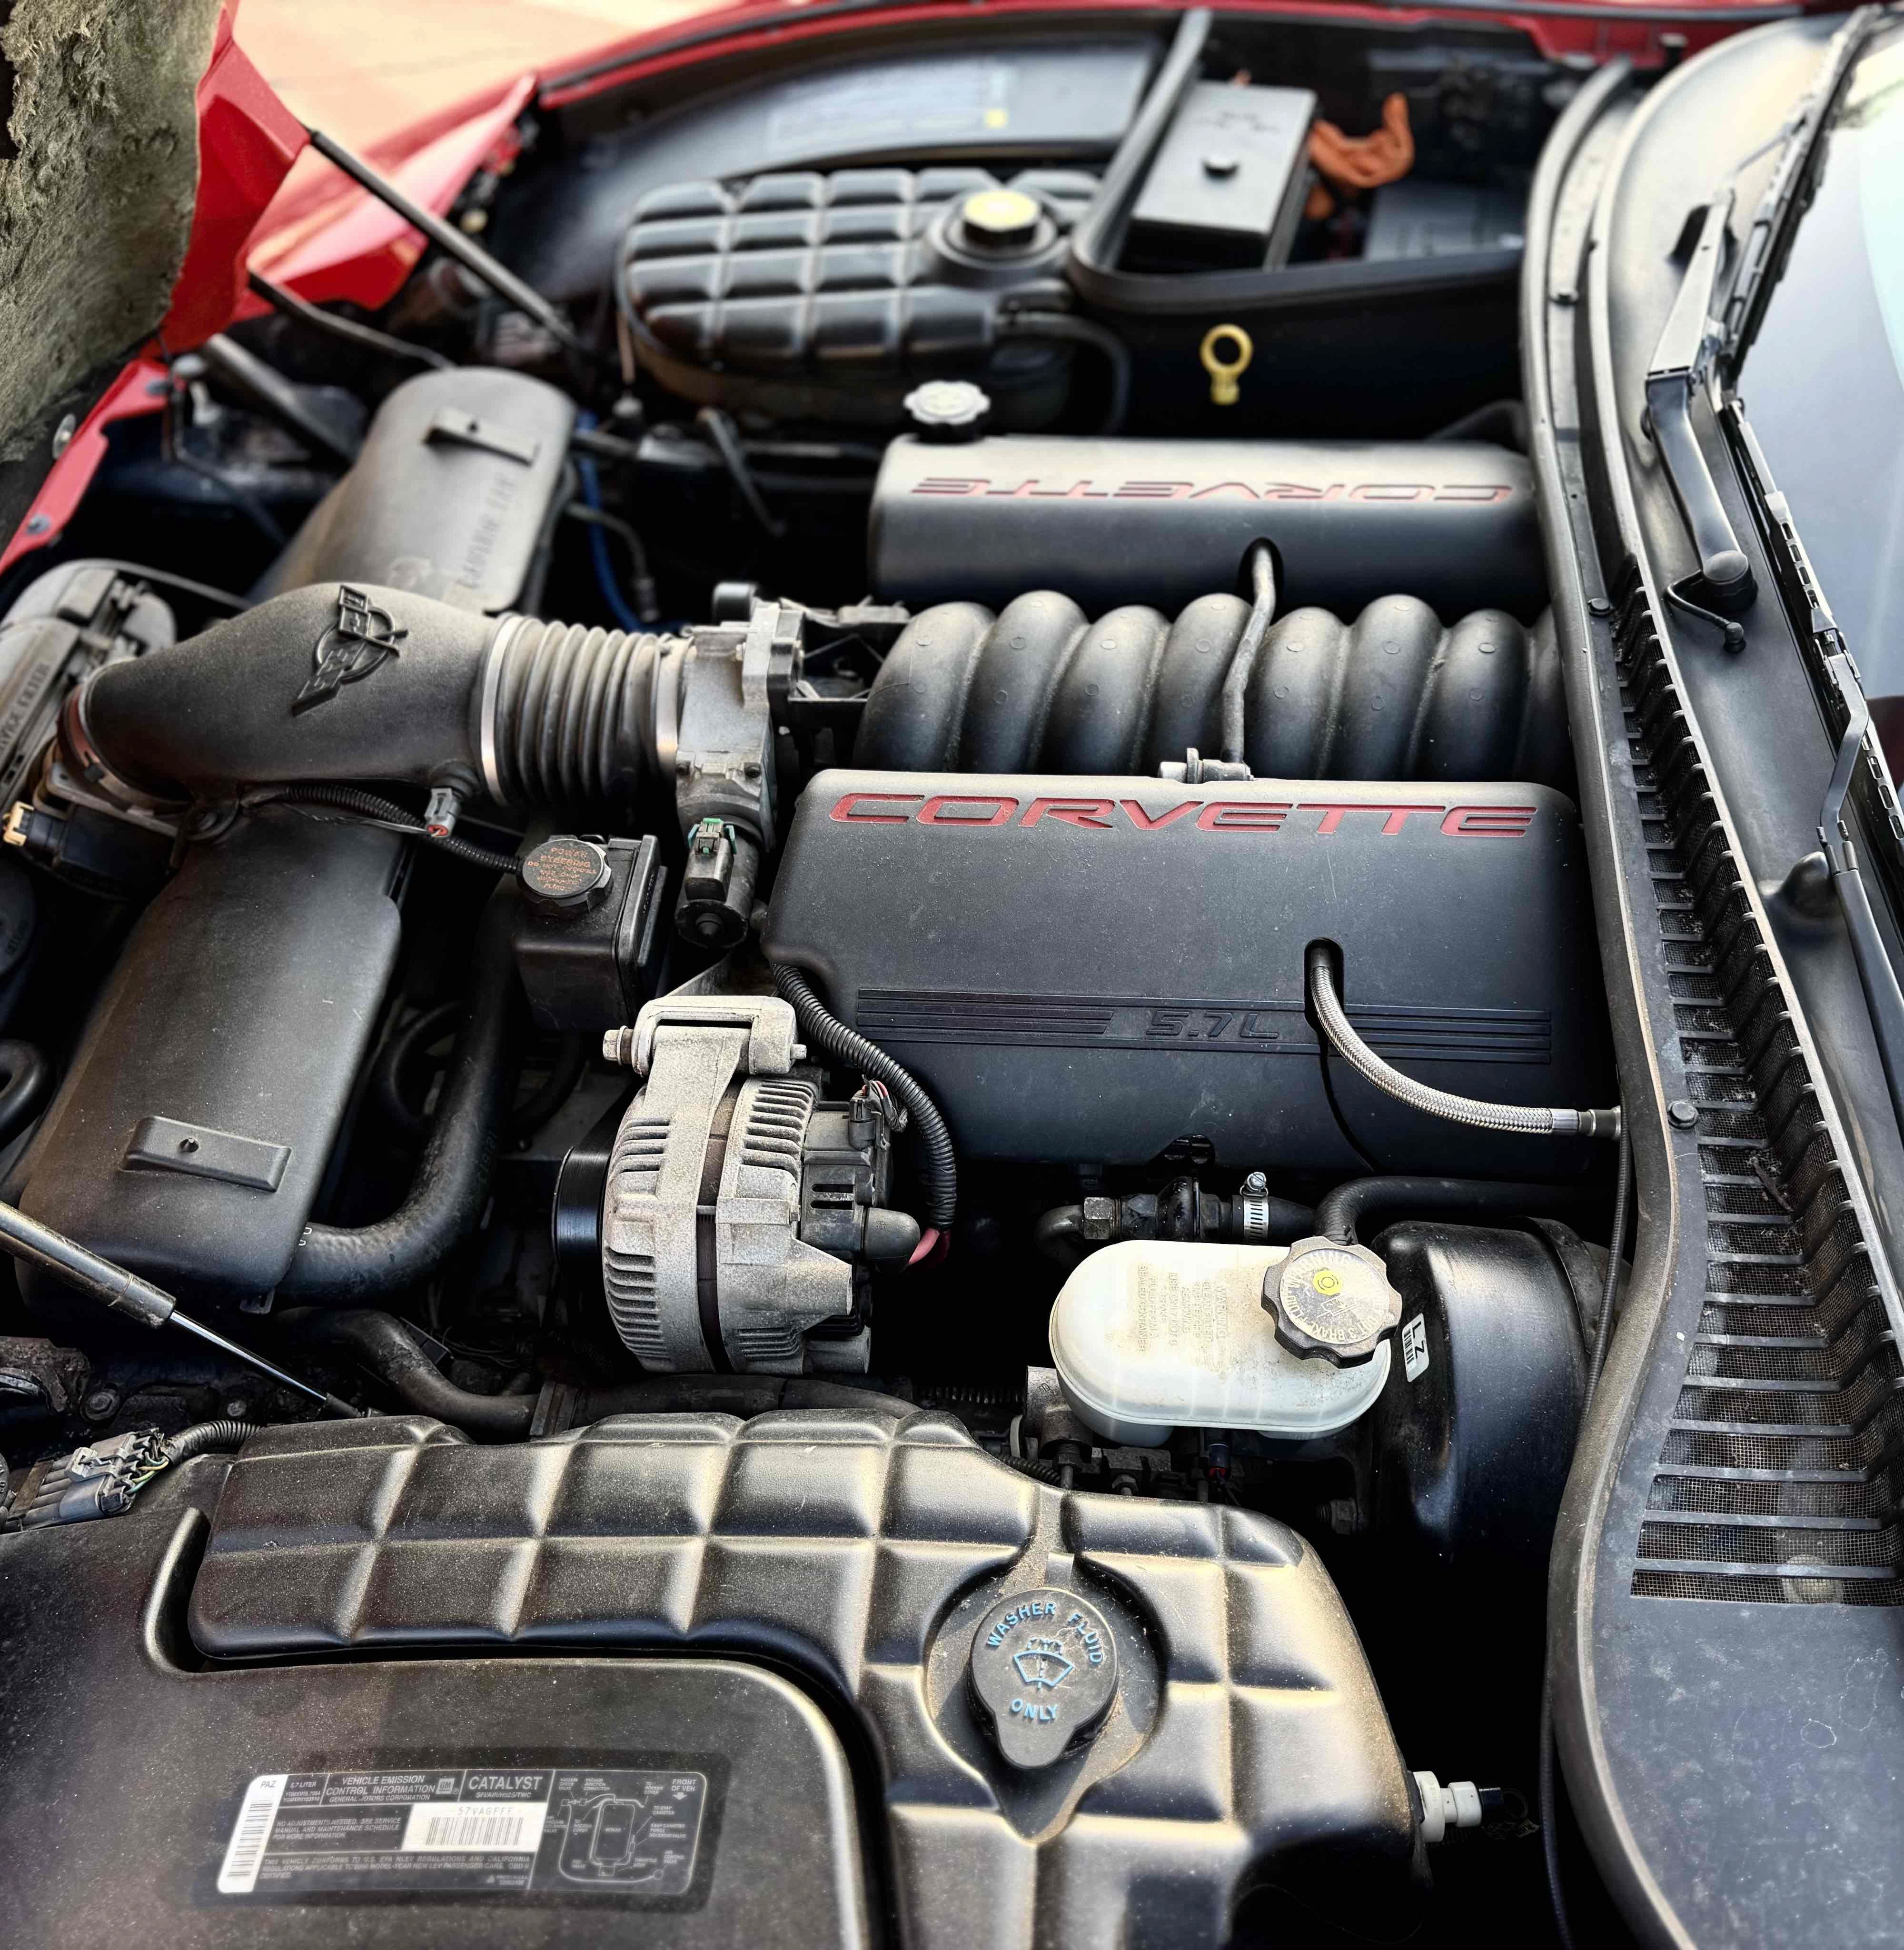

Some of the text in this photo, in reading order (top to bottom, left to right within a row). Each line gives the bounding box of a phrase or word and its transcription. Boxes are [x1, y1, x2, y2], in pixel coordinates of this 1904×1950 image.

[911, 477, 1512, 501] CORVETTE
[828, 792, 1538, 838] CORVETTE
[540, 855, 590, 867] STEERING
[1144, 1010, 1280, 1039] 5.7L
[1287, 1250, 1350, 1288] WARNING
[1169, 1294, 1178, 1317] ONLY
[1202, 1280, 1211, 1310] CLEAN
[1216, 1287, 1227, 1338] WARNING
[1286, 1295, 1378, 1341] DOT 3 BRAKE FLUID
[1412, 1321, 1425, 1358] LZ
[986, 1602, 1103, 1663] WASHER FLUID
[1011, 1698, 1058, 1721] ONLY
[260, 1781, 277, 1789] PAZ
[326, 1785, 436, 1795] CONTROL INFORMATION
[342, 1775, 425, 1785] VEHICLE EMISSION
[469, 1776, 544, 1790] CATALYST
